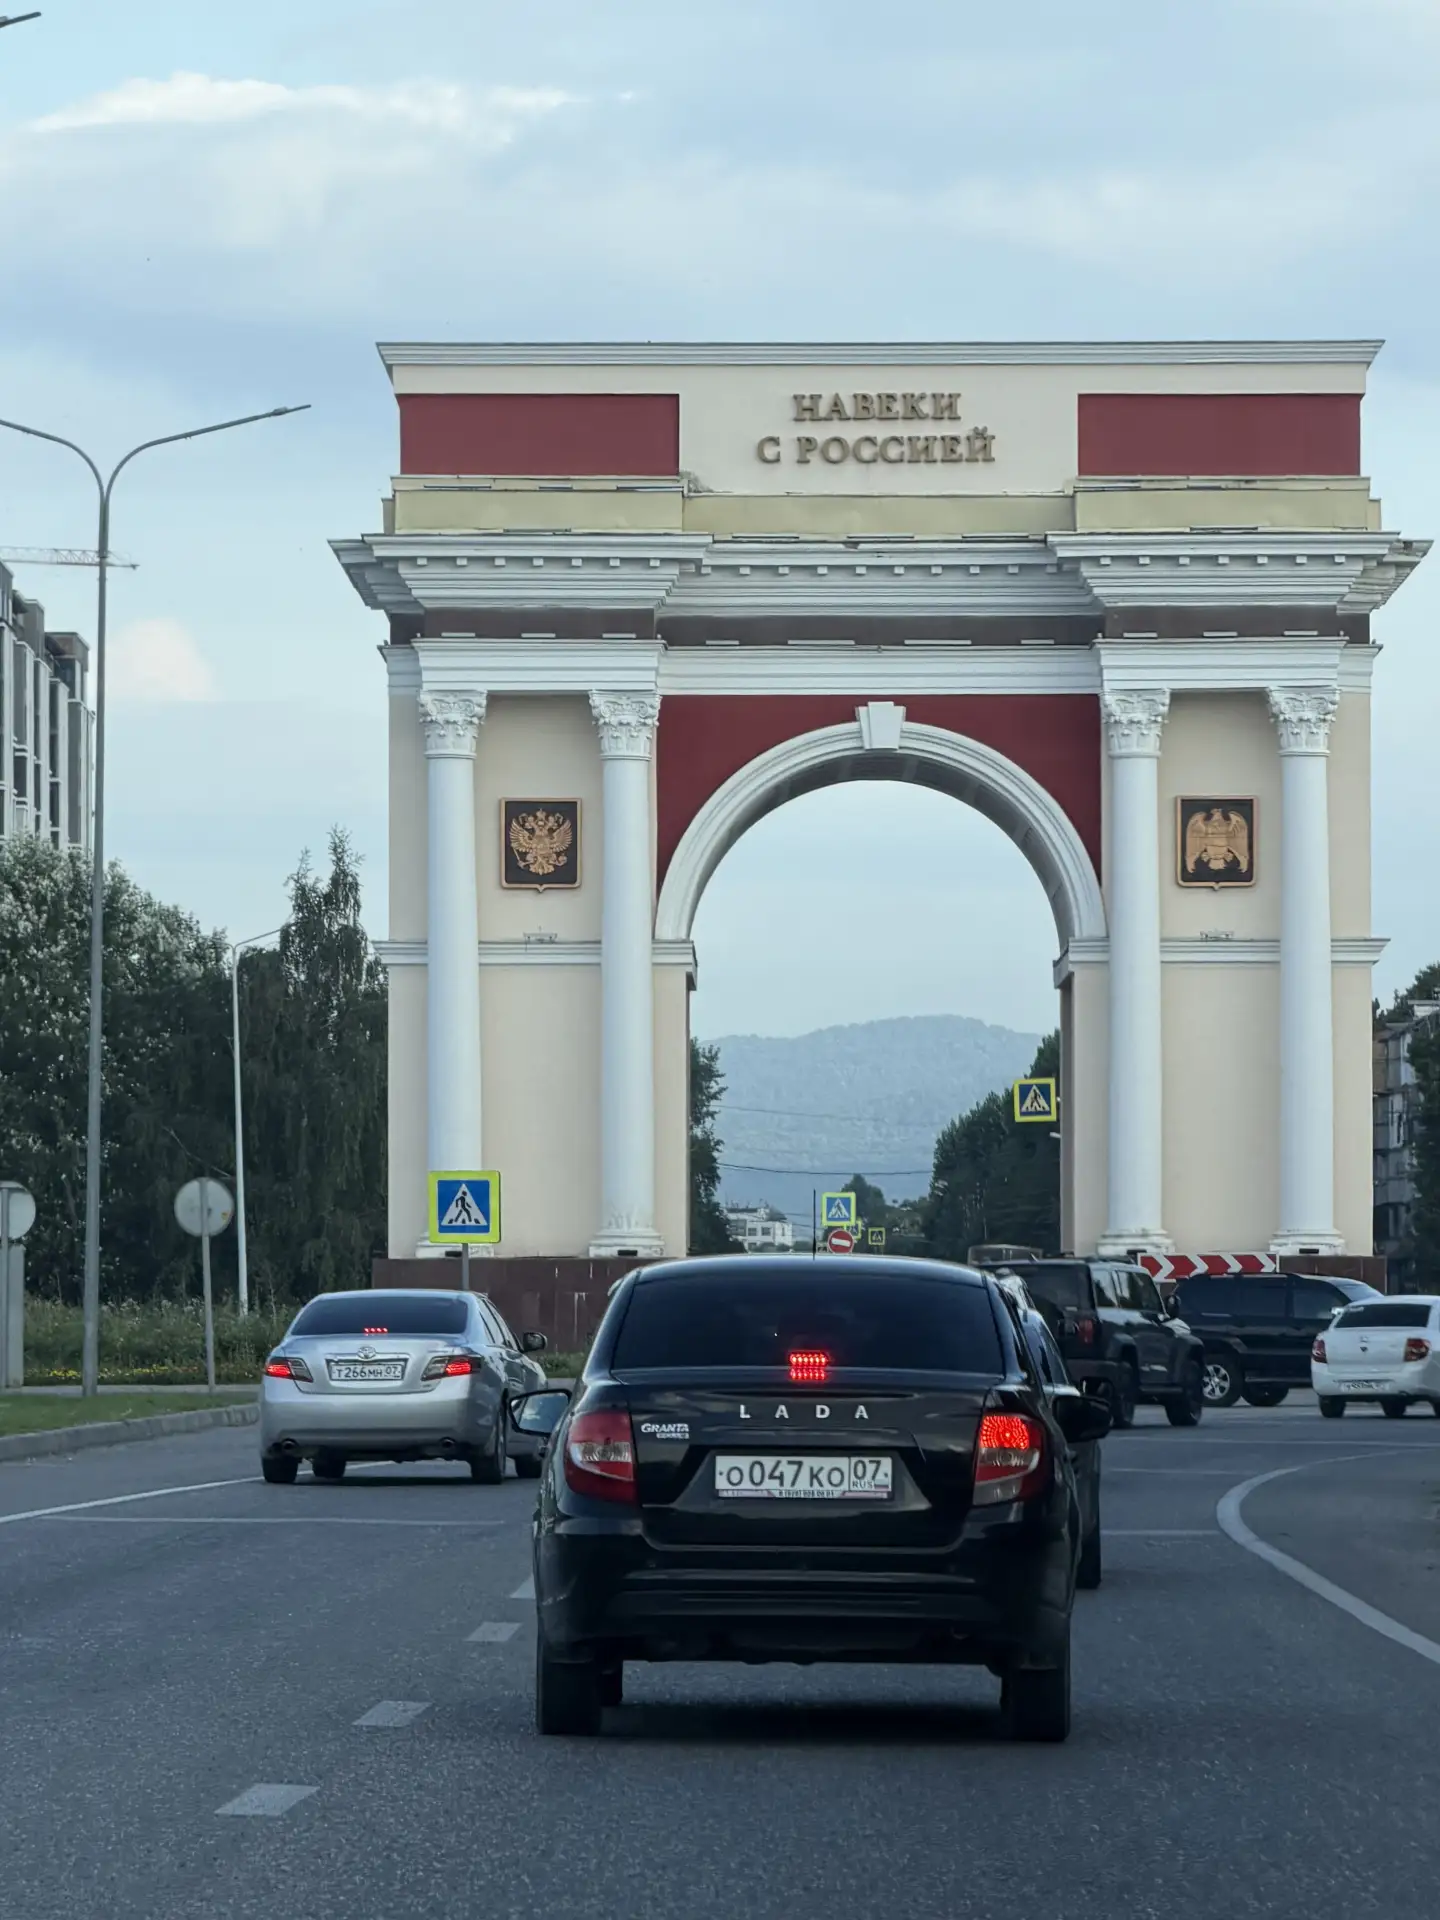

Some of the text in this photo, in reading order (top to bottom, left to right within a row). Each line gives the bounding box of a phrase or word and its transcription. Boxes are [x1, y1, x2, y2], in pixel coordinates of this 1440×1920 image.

[793, 392, 961, 421] НАВЕКИ
[757, 426, 995, 463] С РОССИЕЙ
[739, 1404, 869, 1419] LADA
[853, 1459, 881, 1480] 07
[852, 1481, 873, 1489] RUS
